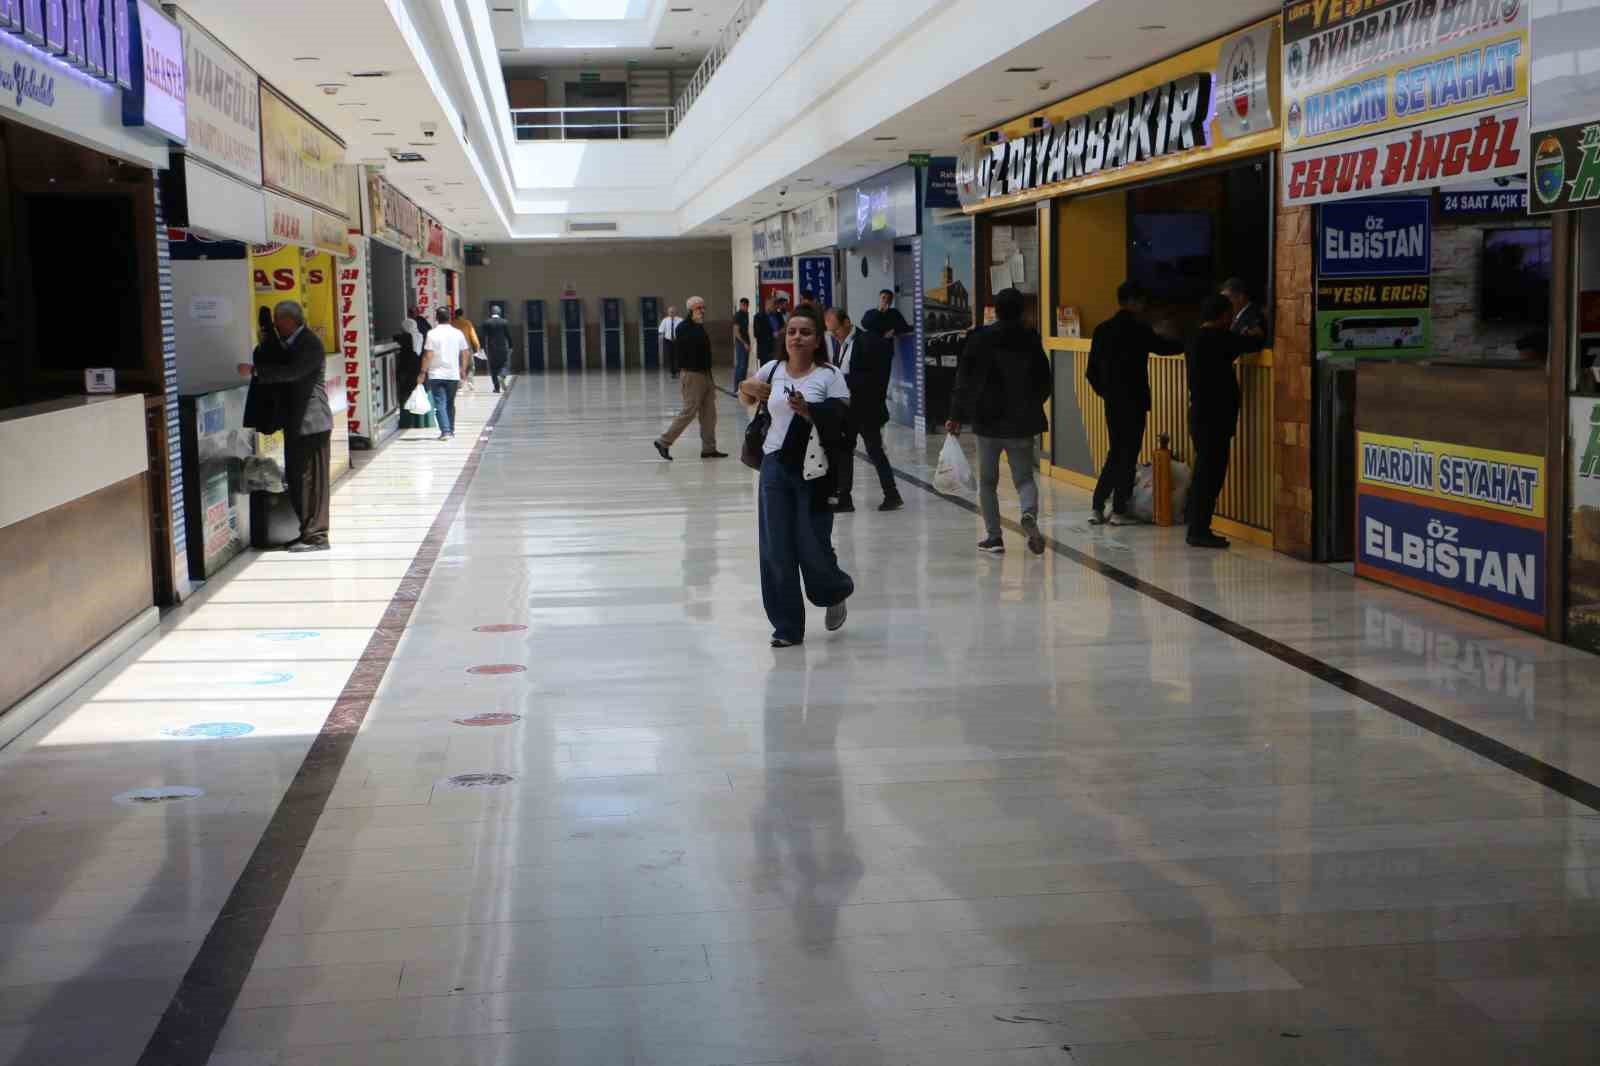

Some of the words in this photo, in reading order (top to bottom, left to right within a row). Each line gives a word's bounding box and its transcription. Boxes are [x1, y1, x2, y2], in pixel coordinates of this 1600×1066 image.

[1303, 73, 1388, 138] MARDİN
[1392, 38, 1521, 118] SEYAHAT
[1380, 114, 1521, 187] BİNGÖL
[1444, 196, 1457, 211] 24
[1460, 195, 1489, 209] SAAT
[1491, 194, 1518, 213] AÇIK
[1365, 215, 1384, 230] ÖZ
[805, 260, 813, 291] ELA
[1363, 443, 1433, 489] MARDİN
[1439, 453, 1538, 508] SEYAHAT
[1427, 519, 1458, 543] ÖZ
